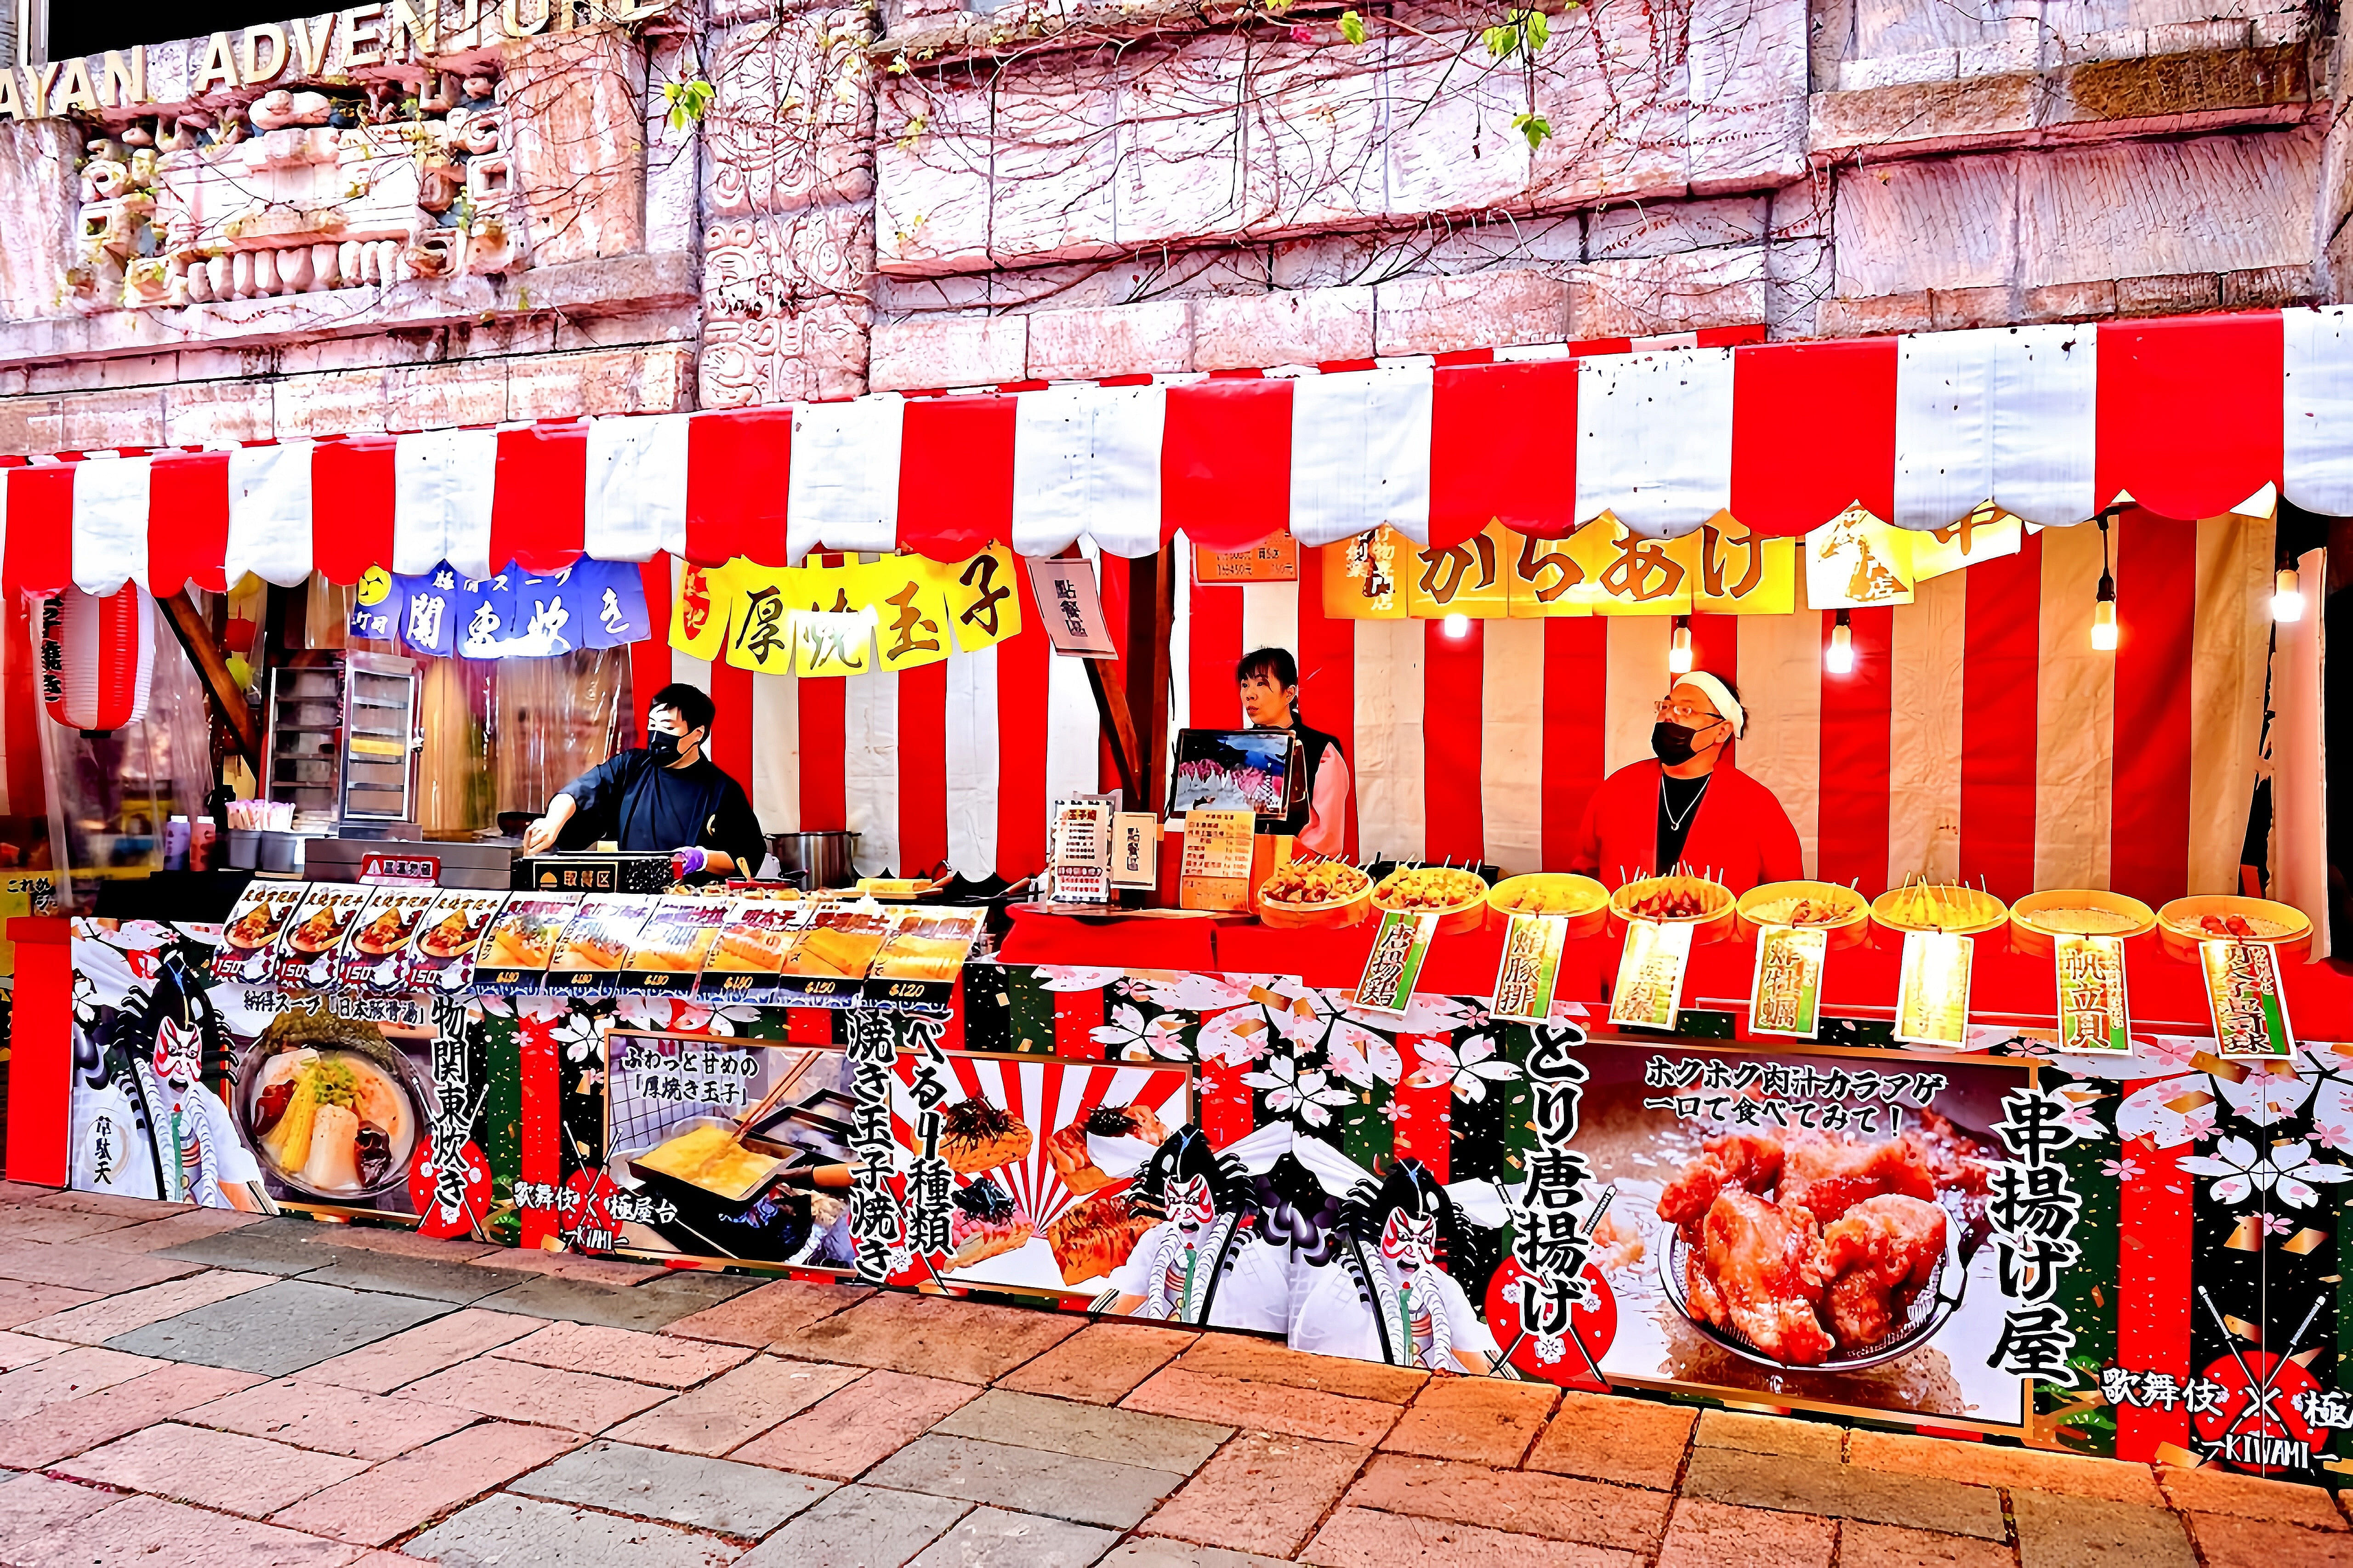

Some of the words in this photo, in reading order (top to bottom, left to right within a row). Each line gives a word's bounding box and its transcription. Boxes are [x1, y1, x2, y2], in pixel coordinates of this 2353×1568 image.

[1419, 523, 1777, 605] からあげ
[2066, 950, 2111, 1047] 帆立貝
[624, 1047, 758, 1076] ふわっと甘めの
[1647, 1058, 1948, 1104] ホクホク肉汁カラアゲ
[906, 1010, 953, 1256] べる4種類
[1518, 1024, 1591, 1335] とり唐揚げ
[1988, 1093, 2078, 1384] 串揚げ屋
